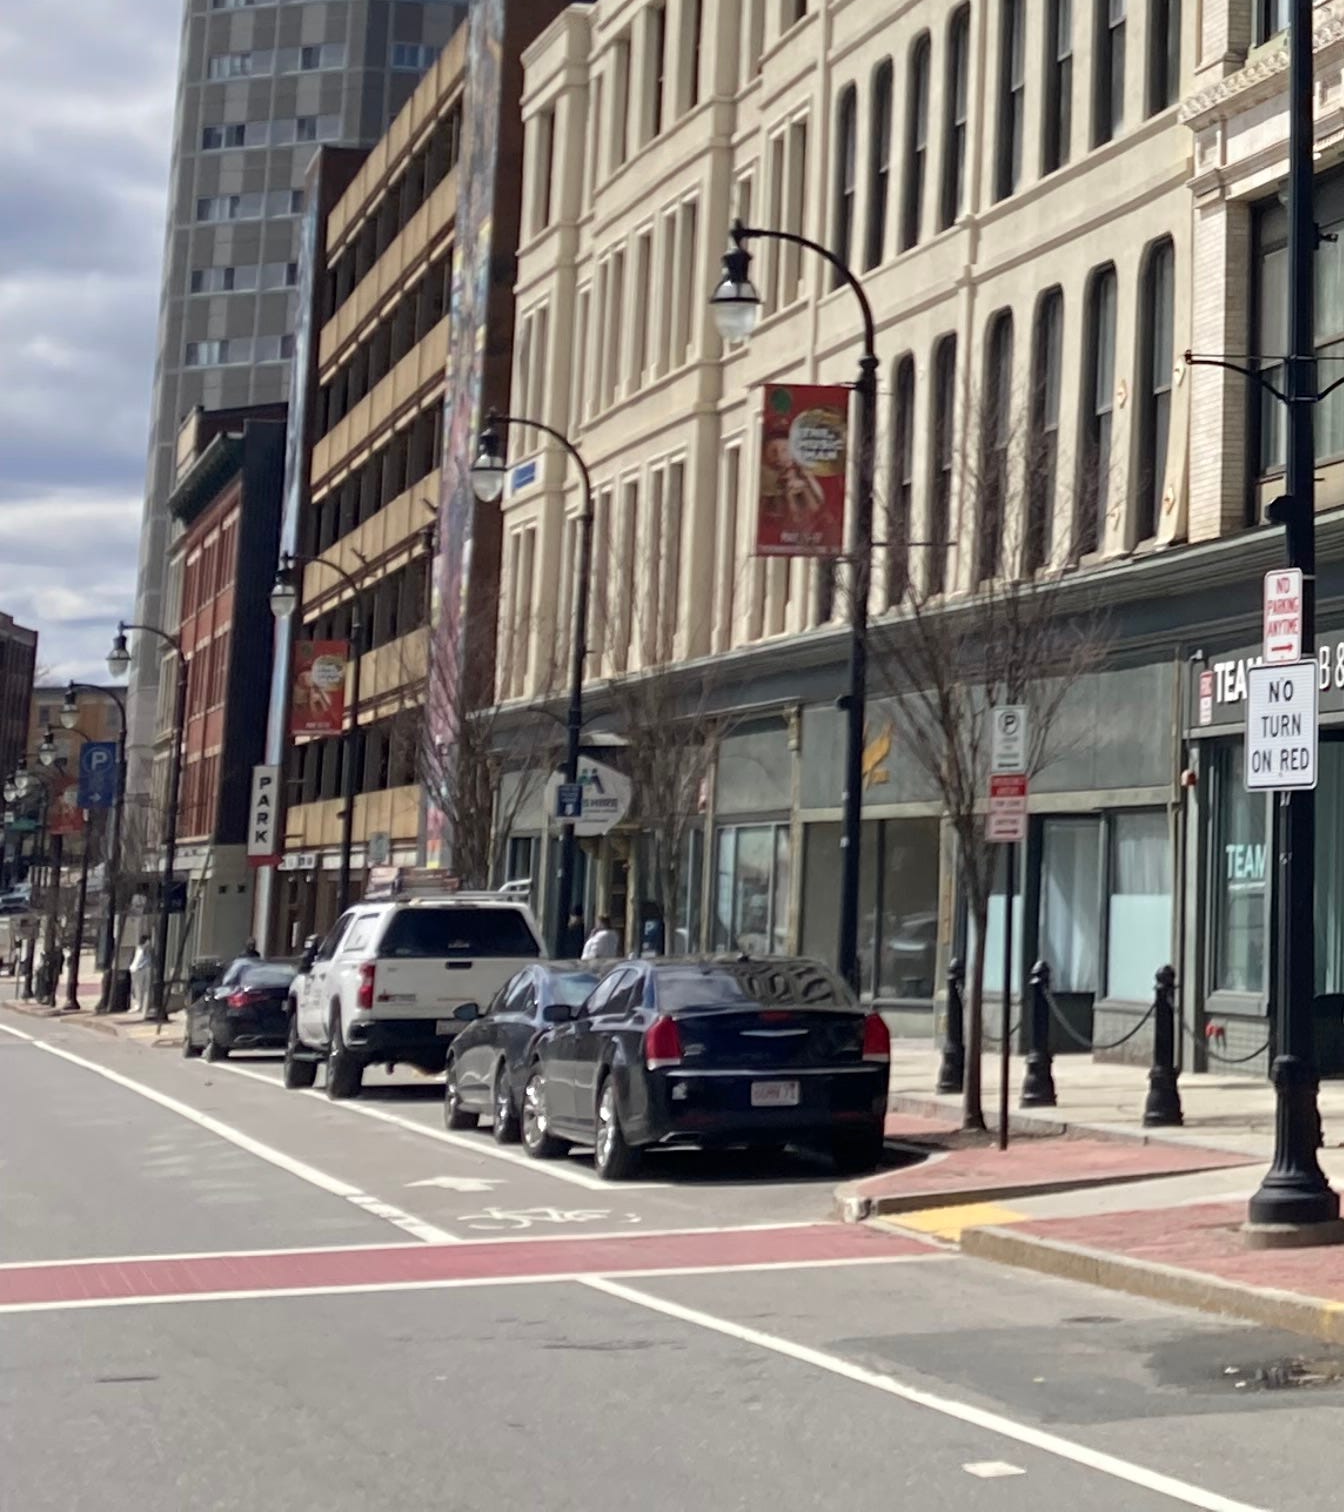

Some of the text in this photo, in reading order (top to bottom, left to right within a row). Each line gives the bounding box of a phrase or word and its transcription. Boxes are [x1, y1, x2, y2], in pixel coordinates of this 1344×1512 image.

[1276, 577, 1291, 594] NO
[1267, 597, 1298, 615] PARKING
[1267, 618, 1298, 636] ANYTIME
[1214, 656, 1263, 702] TEA
[1268, 679, 1294, 703] NO
[1261, 713, 1302, 738] TURN
[1252, 747, 1310, 774] ON RED
[255, 777, 271, 843] PARK
